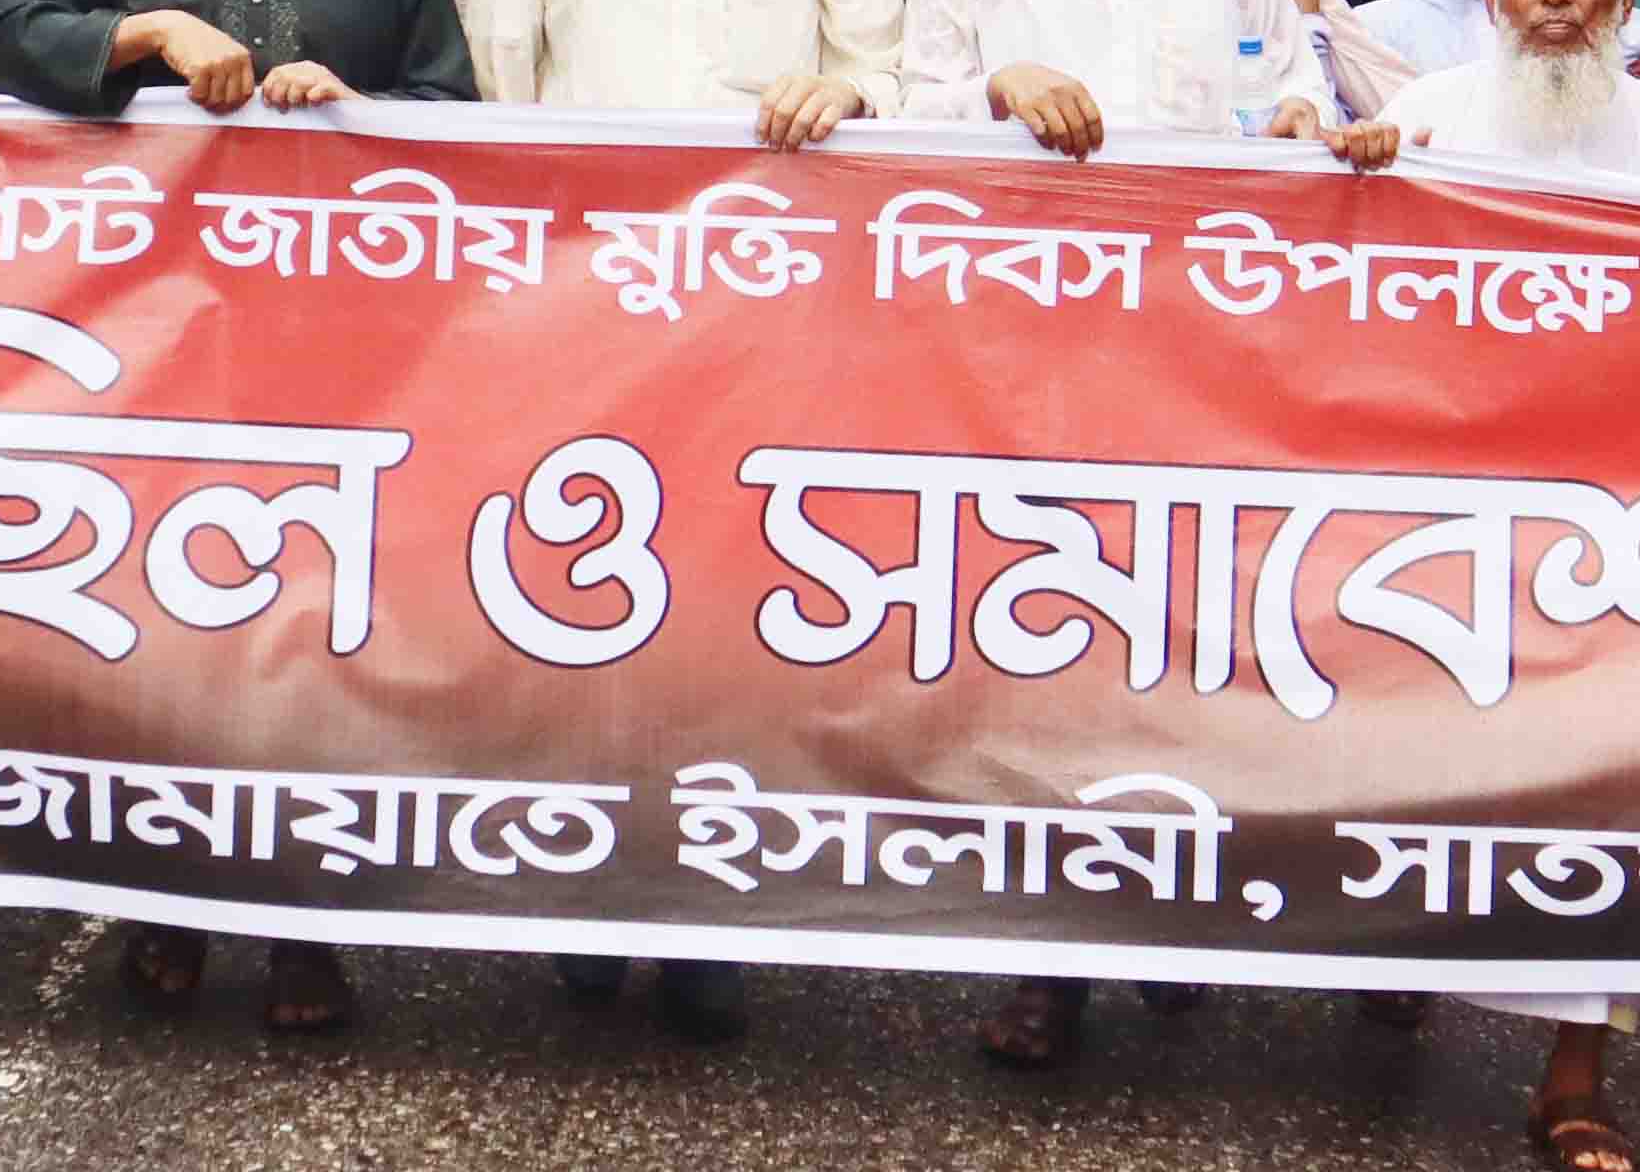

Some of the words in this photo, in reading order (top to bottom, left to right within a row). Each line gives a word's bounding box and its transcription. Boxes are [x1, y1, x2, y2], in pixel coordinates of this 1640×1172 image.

[194, 167, 554, 294] জাতীয়
[583, 181, 838, 323] মুক্তি
[867, 190, 1151, 311] দিবস
[1183, 211, 1640, 335] উপলক্ষে
[468, 434, 671, 667] ও
[670, 761, 1285, 922] ইসলামী,
